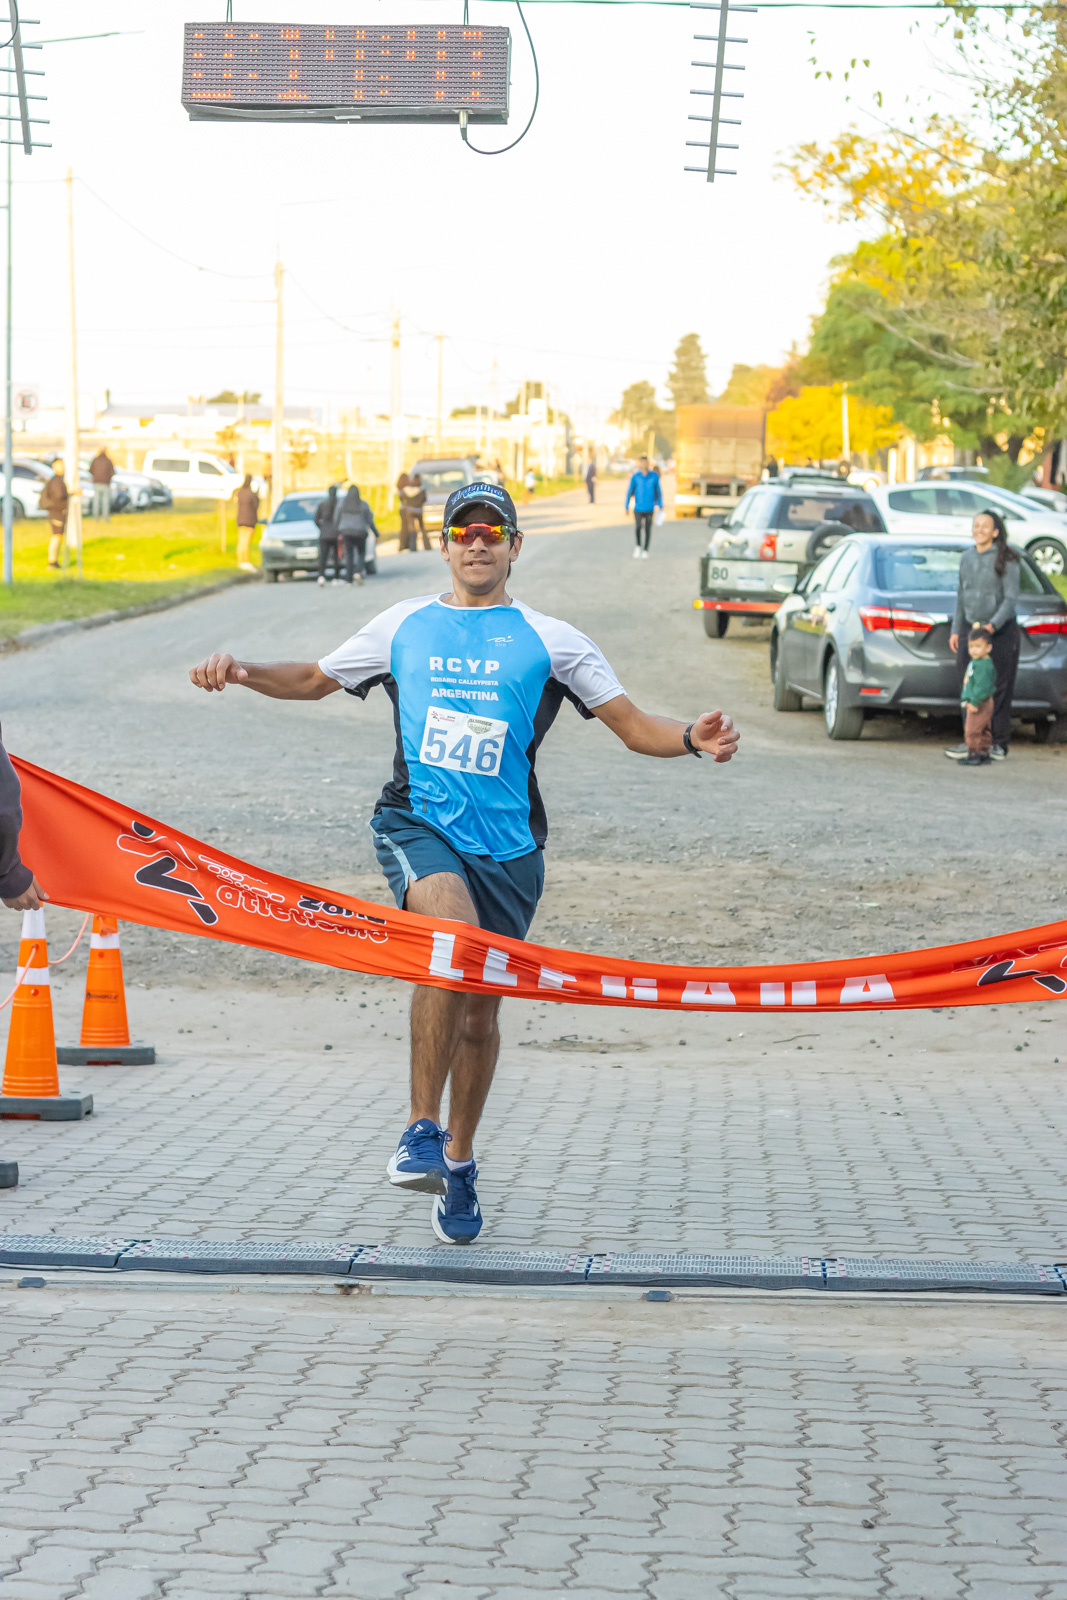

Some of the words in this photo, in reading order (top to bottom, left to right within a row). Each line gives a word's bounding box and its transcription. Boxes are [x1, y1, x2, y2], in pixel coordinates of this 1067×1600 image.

[711, 566, 729, 580] 80
[430, 676, 457, 684] ROSARIO
[431, 688, 500, 702] ARGENTINA
[424, 727, 500, 773] 546
